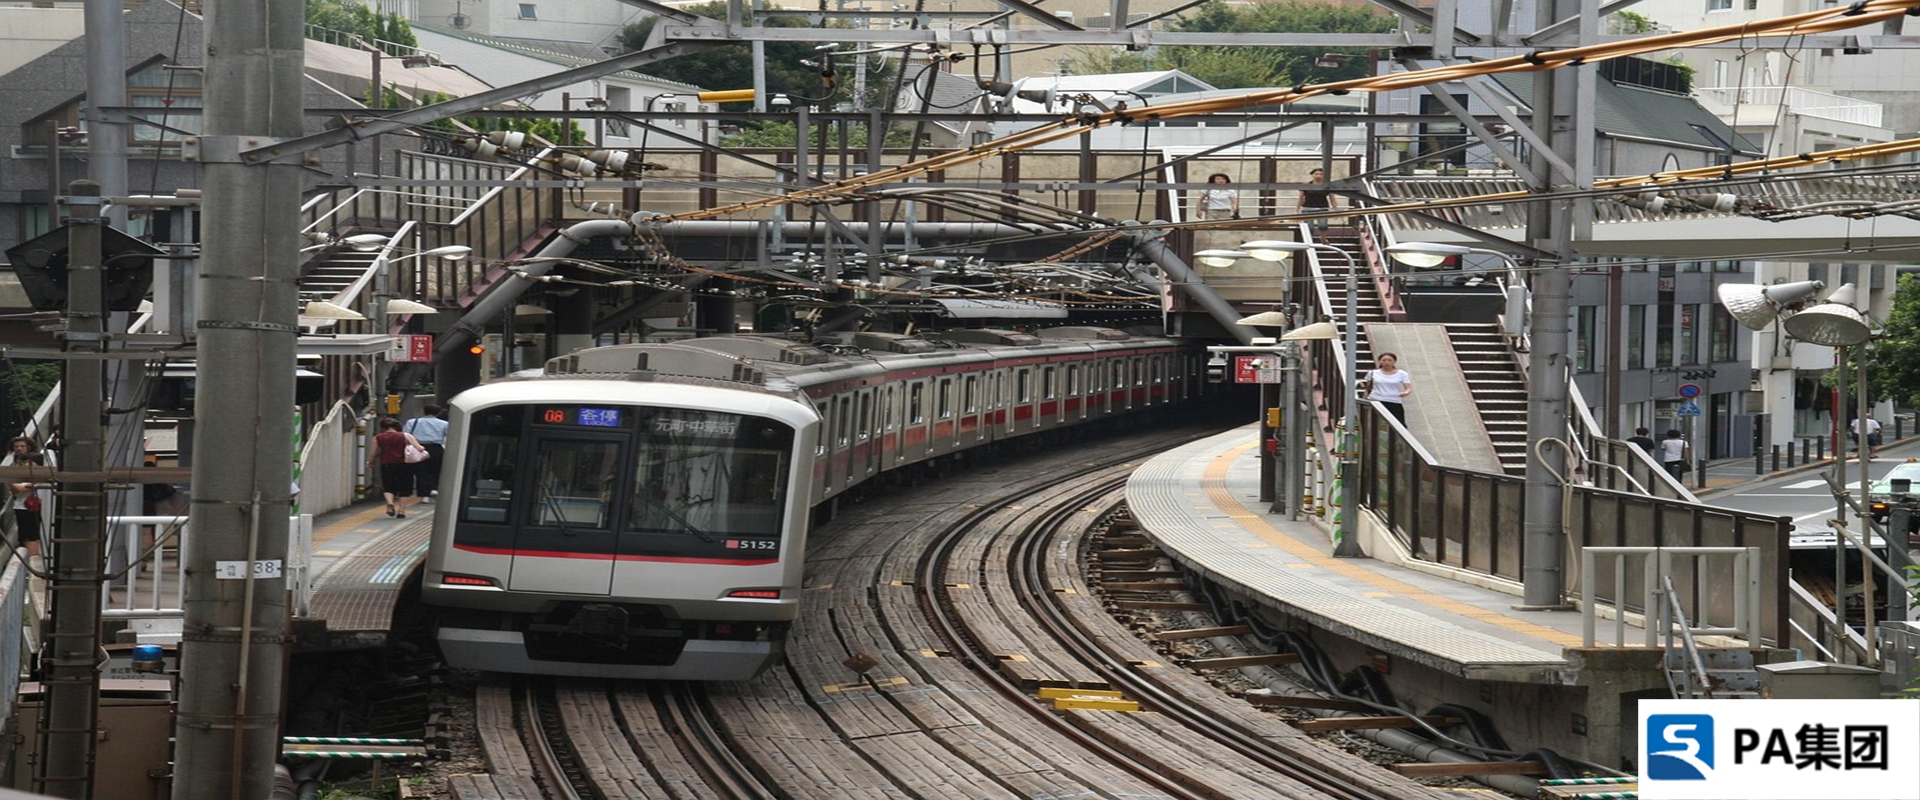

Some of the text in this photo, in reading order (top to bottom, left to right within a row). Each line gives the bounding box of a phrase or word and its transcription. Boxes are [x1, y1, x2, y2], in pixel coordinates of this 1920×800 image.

[544, 410, 564, 422] 08
[581, 409, 617, 421] 各停
[740, 540, 776, 550] 5152
